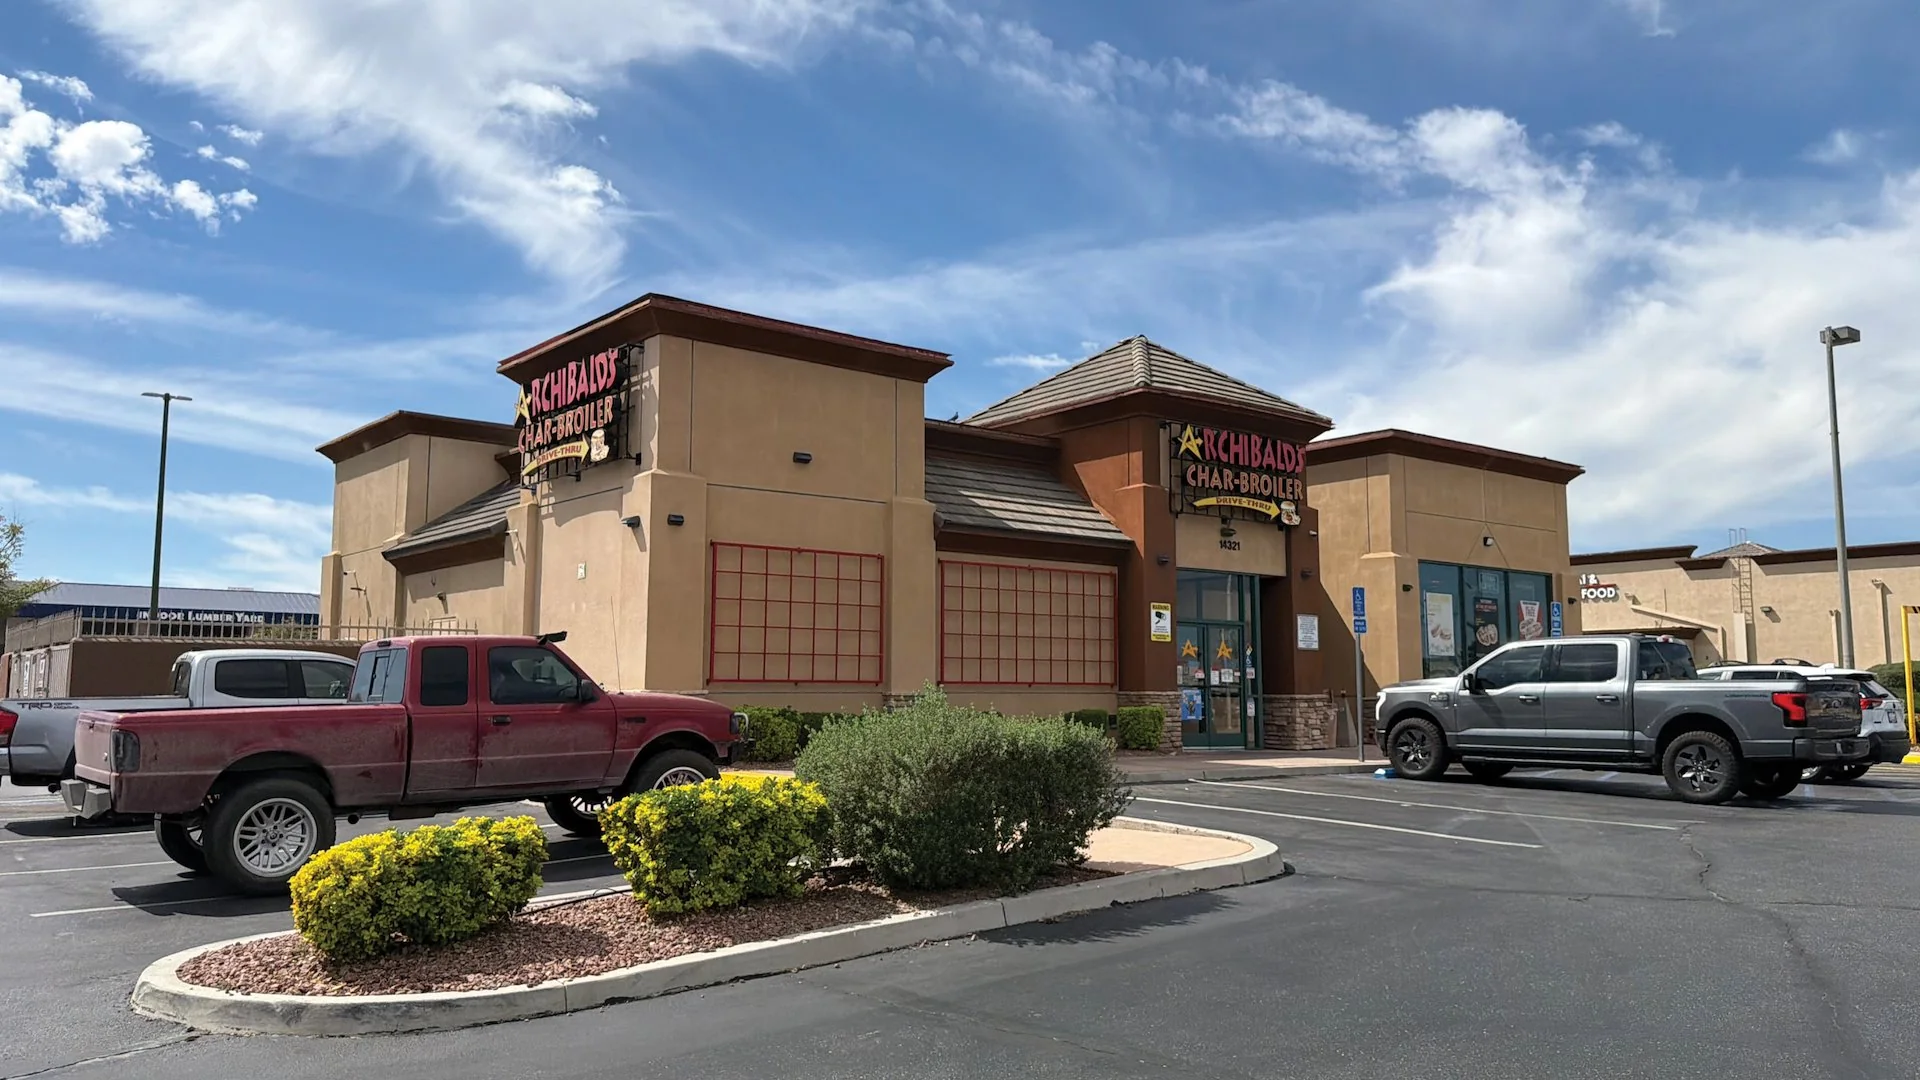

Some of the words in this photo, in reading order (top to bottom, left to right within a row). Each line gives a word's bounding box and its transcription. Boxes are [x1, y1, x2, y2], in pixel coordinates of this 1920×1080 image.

[518, 395, 614, 453] CHAR-BROILER
[536, 445, 582, 465] DRIVE-THRU
[1186, 464, 1304, 500] CHAR-BROILER
[1215, 496, 1272, 511] DRIVE-THRU
[1219, 539, 1241, 551] 14321
[1588, 574, 1598, 584] &
[1581, 587, 1616, 599] FOOD
[139, 610, 185, 620] INOOR
[188, 611, 233, 622] LUMBER
[234, 612, 264, 623] YARD
[17, 702, 53, 710] TRD
